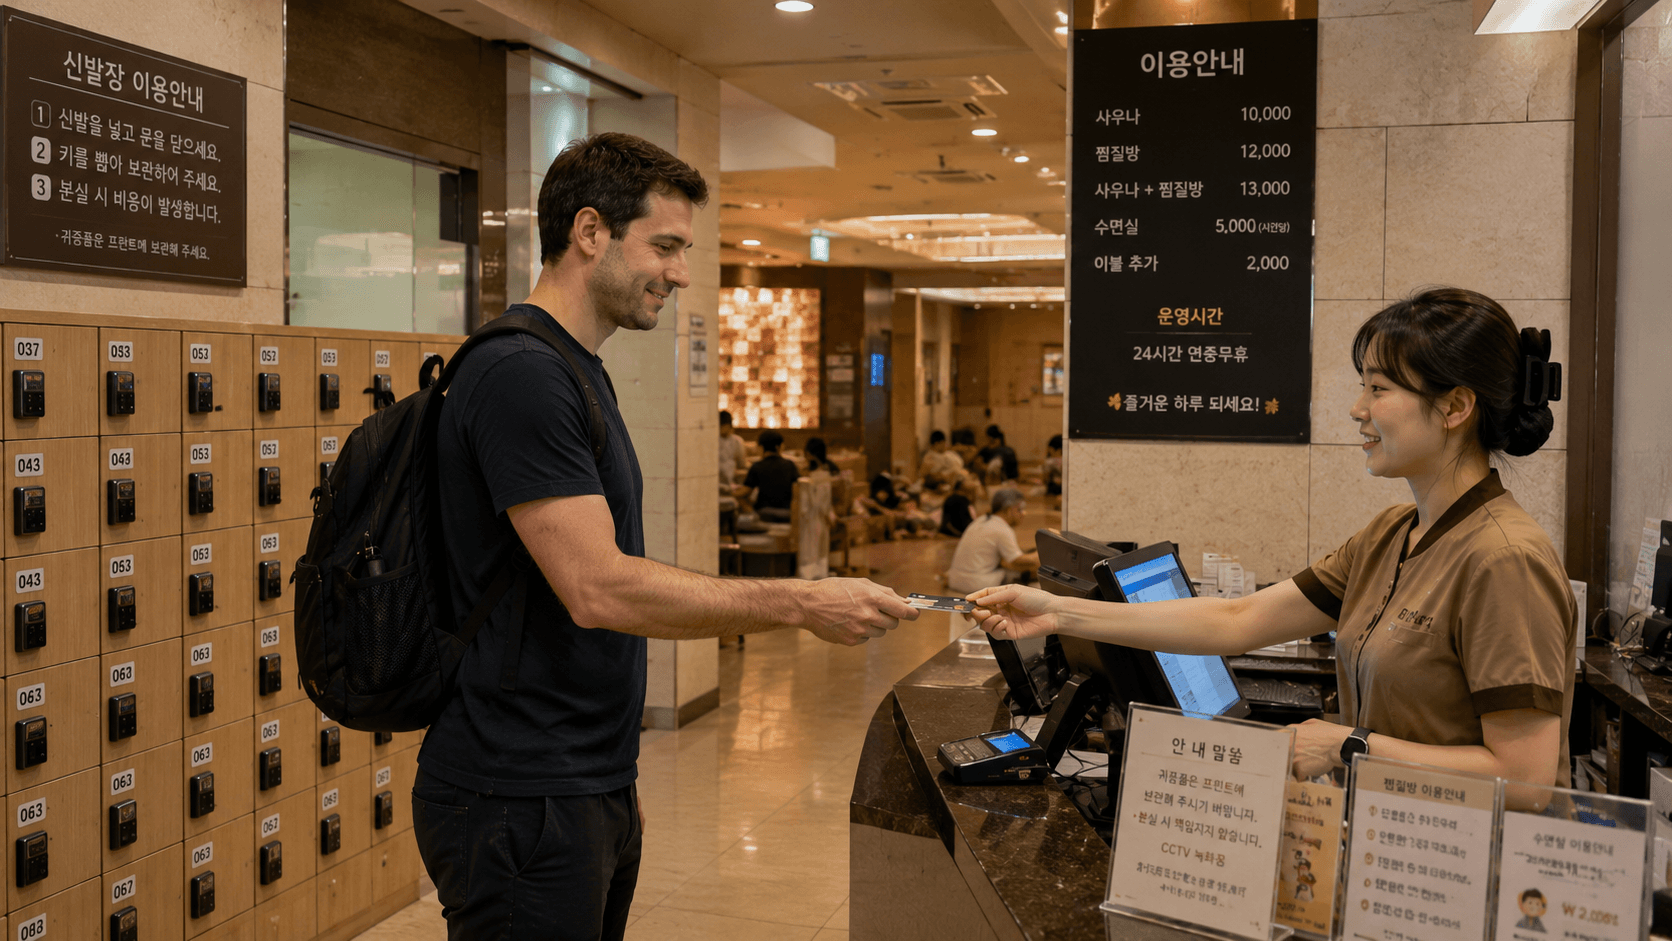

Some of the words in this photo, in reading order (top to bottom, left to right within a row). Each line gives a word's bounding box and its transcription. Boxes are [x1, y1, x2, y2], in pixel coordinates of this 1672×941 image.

[1140, 48, 1244, 78] 이용안내
[63, 50, 125, 92] 신발장
[133, 72, 203, 113] 이용안내
[1095, 108, 1141, 126] 사우나
[1241, 106, 1291, 123] 10,000
[38, 106, 43, 123] 1
[58, 108, 103, 137] 신발을
[140, 127, 165, 152] 문을
[1095, 145, 1140, 162] 찜질방
[1240, 143, 1291, 160] 12,000
[36, 142, 46, 160] 2
[59, 145, 88, 170] 키를
[183, 169, 221, 194] 주세요.
[36, 178, 46, 196] 3
[94, 186, 108, 208] 시
[1094, 182, 1140, 199] 사우나
[1158, 181, 1204, 198] 찜질방
[1240, 180, 1290, 197] 13,000
[1094, 218, 1139, 236] 수면실
[1094, 256, 1124, 272] 이불
[1128, 255, 1159, 272] 추가
[1246, 256, 1290, 272] 2,000
[1157, 306, 1224, 326] 운영시간
[18, 342, 40, 356] 037
[1133, 346, 1183, 362] 24시간
[1188, 346, 1248, 362] 연중무휴
[1123, 394, 1168, 412] 즐거운
[1174, 395, 1204, 412] 하루
[1209, 396, 1260, 412] 되세요!
[192, 448, 209, 460] 053
[18, 458, 40, 473] 043
[18, 572, 41, 589] 043
[193, 646, 210, 662] 063
[20, 688, 42, 706] 063
[193, 747, 210, 762] 063
[20, 802, 43, 822] 063
[1160, 816, 1171, 829] 시
[194, 846, 211, 864] 063
[1161, 842, 1191, 858] CCTV
[114, 880, 134, 898] 067
